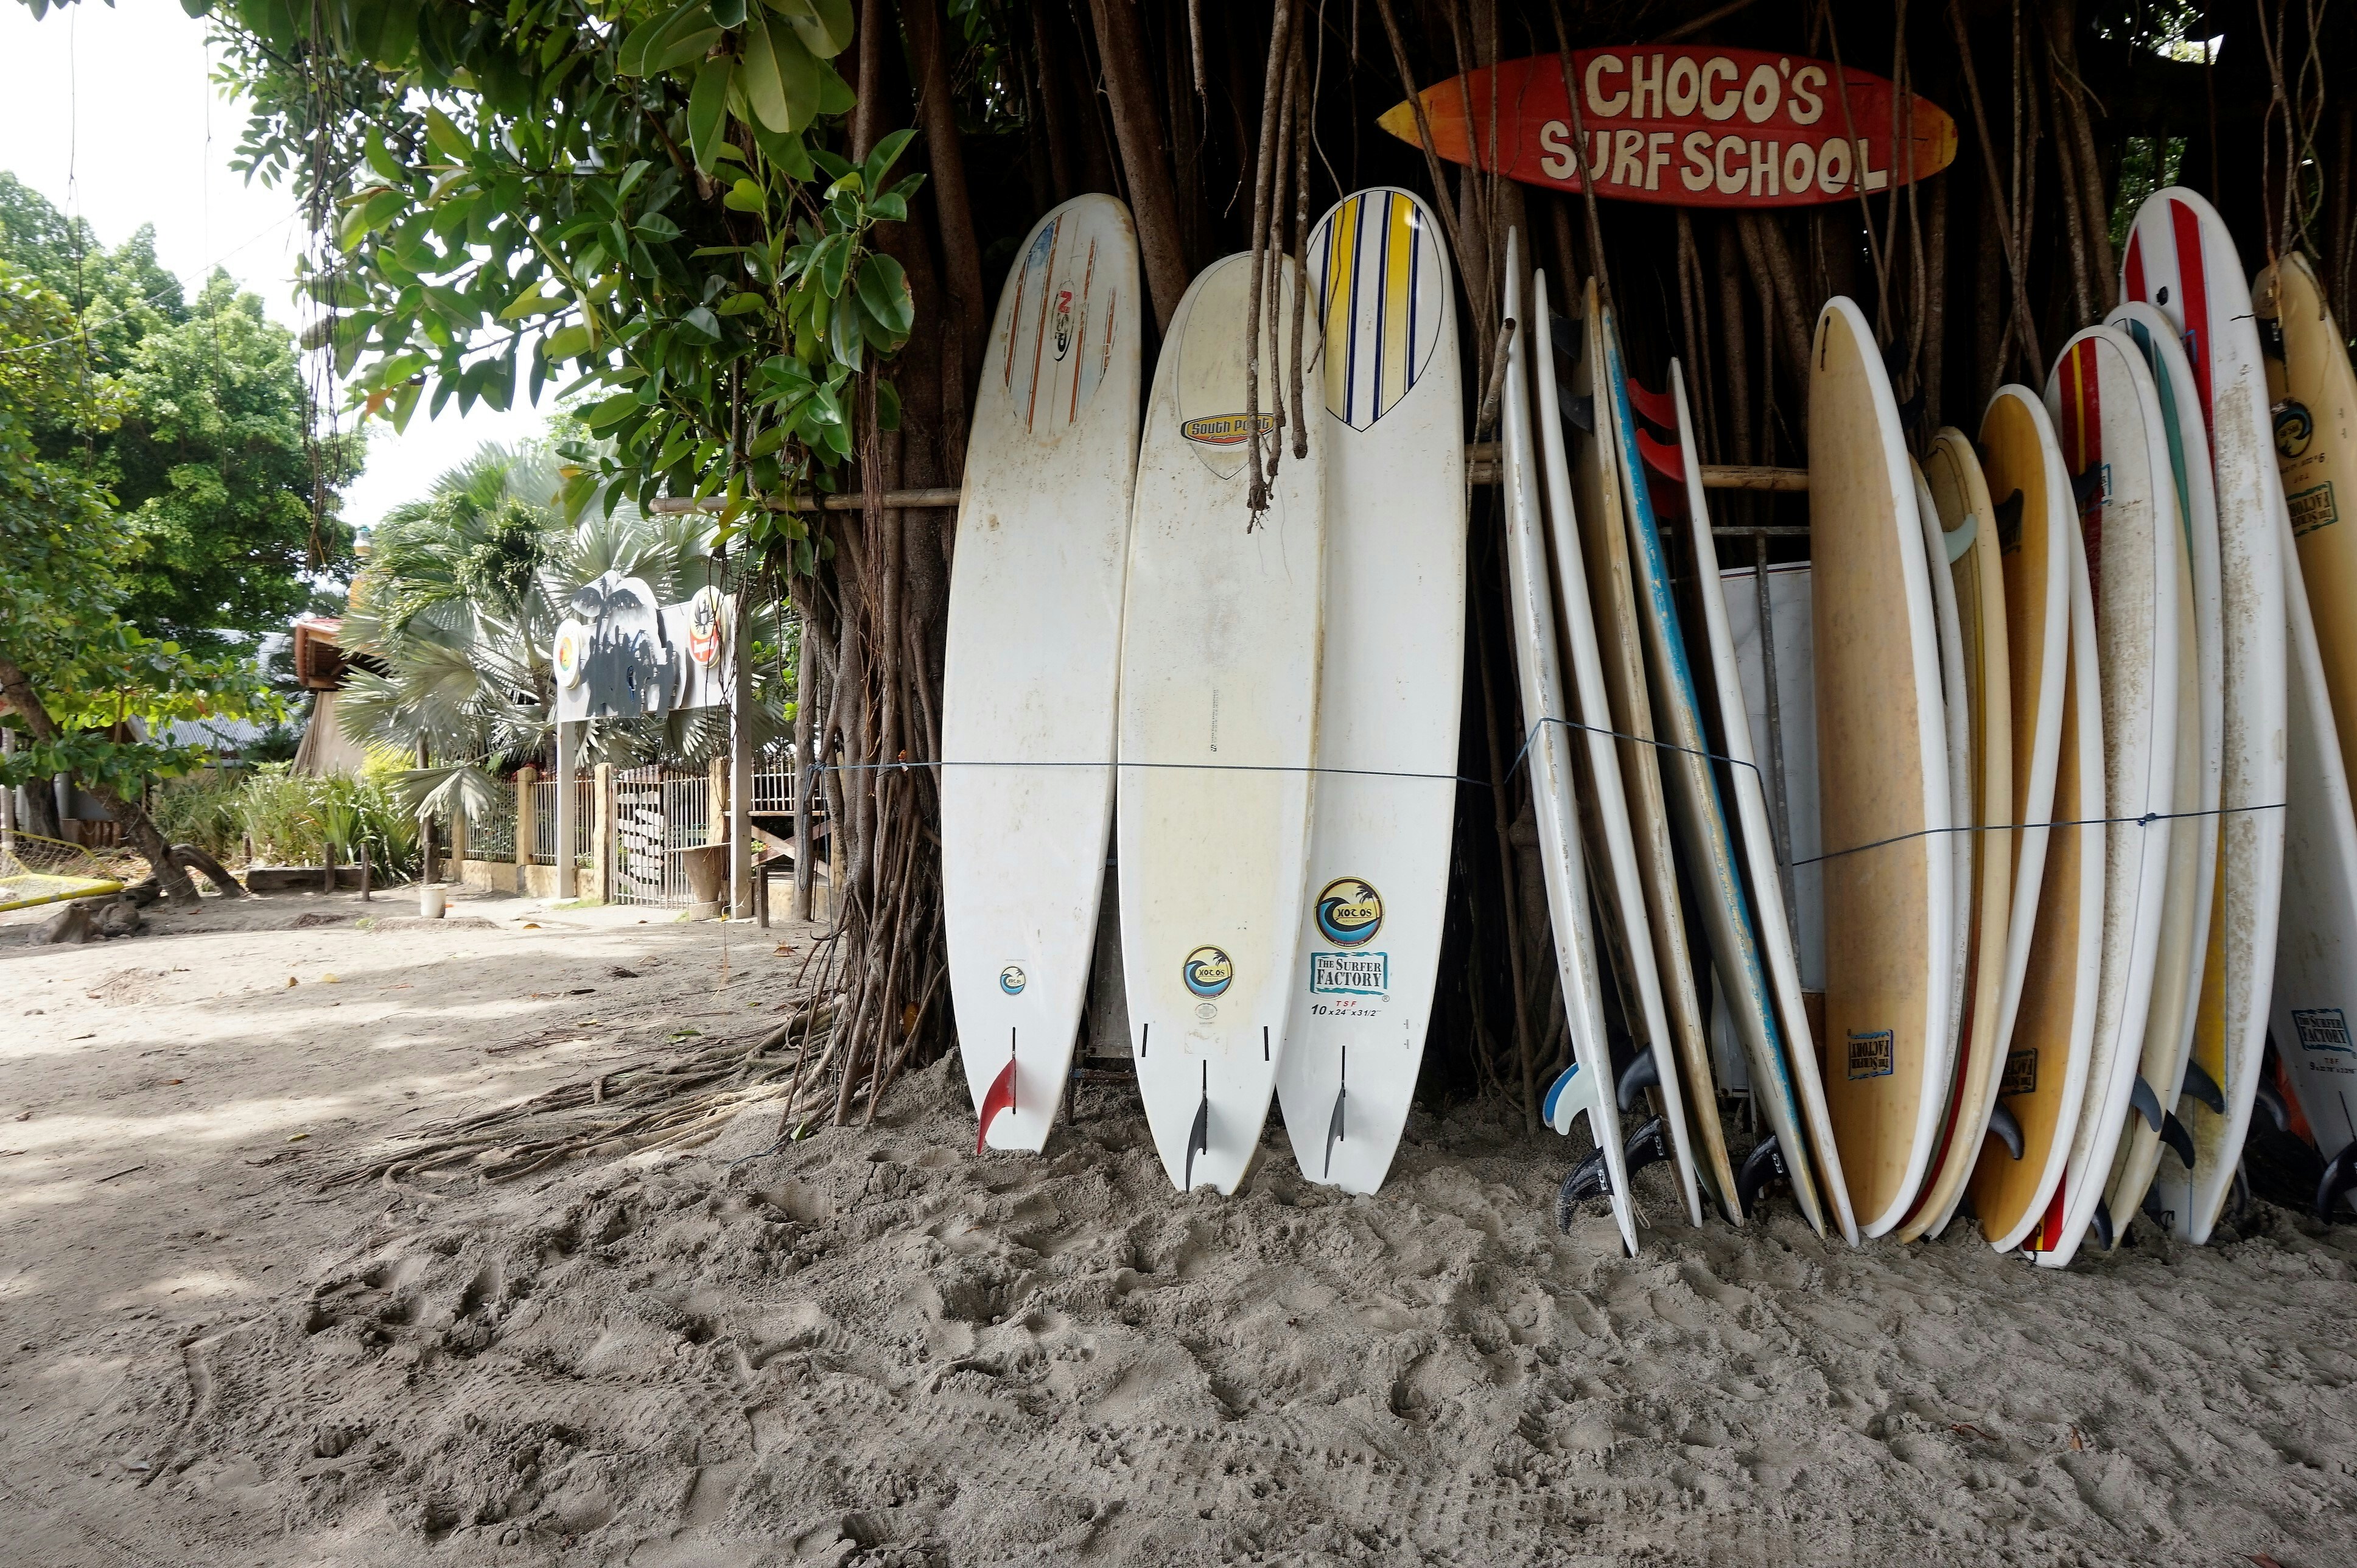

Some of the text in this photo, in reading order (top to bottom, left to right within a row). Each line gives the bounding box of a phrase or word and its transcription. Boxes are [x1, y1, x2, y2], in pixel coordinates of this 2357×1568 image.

[1585, 54, 1827, 125] CHOCO'S
[1192, 421, 1230, 435] South
[1317, 959, 1381, 971] THE SURFER
[1317, 969, 1381, 987] FACTORY
[2300, 1026, 2347, 1043] FACTORY
[1851, 1040, 1889, 1058] FACTORY
[1771, 1153, 1784, 1174] FCS
[1597, 1169, 1607, 1191] FCS
